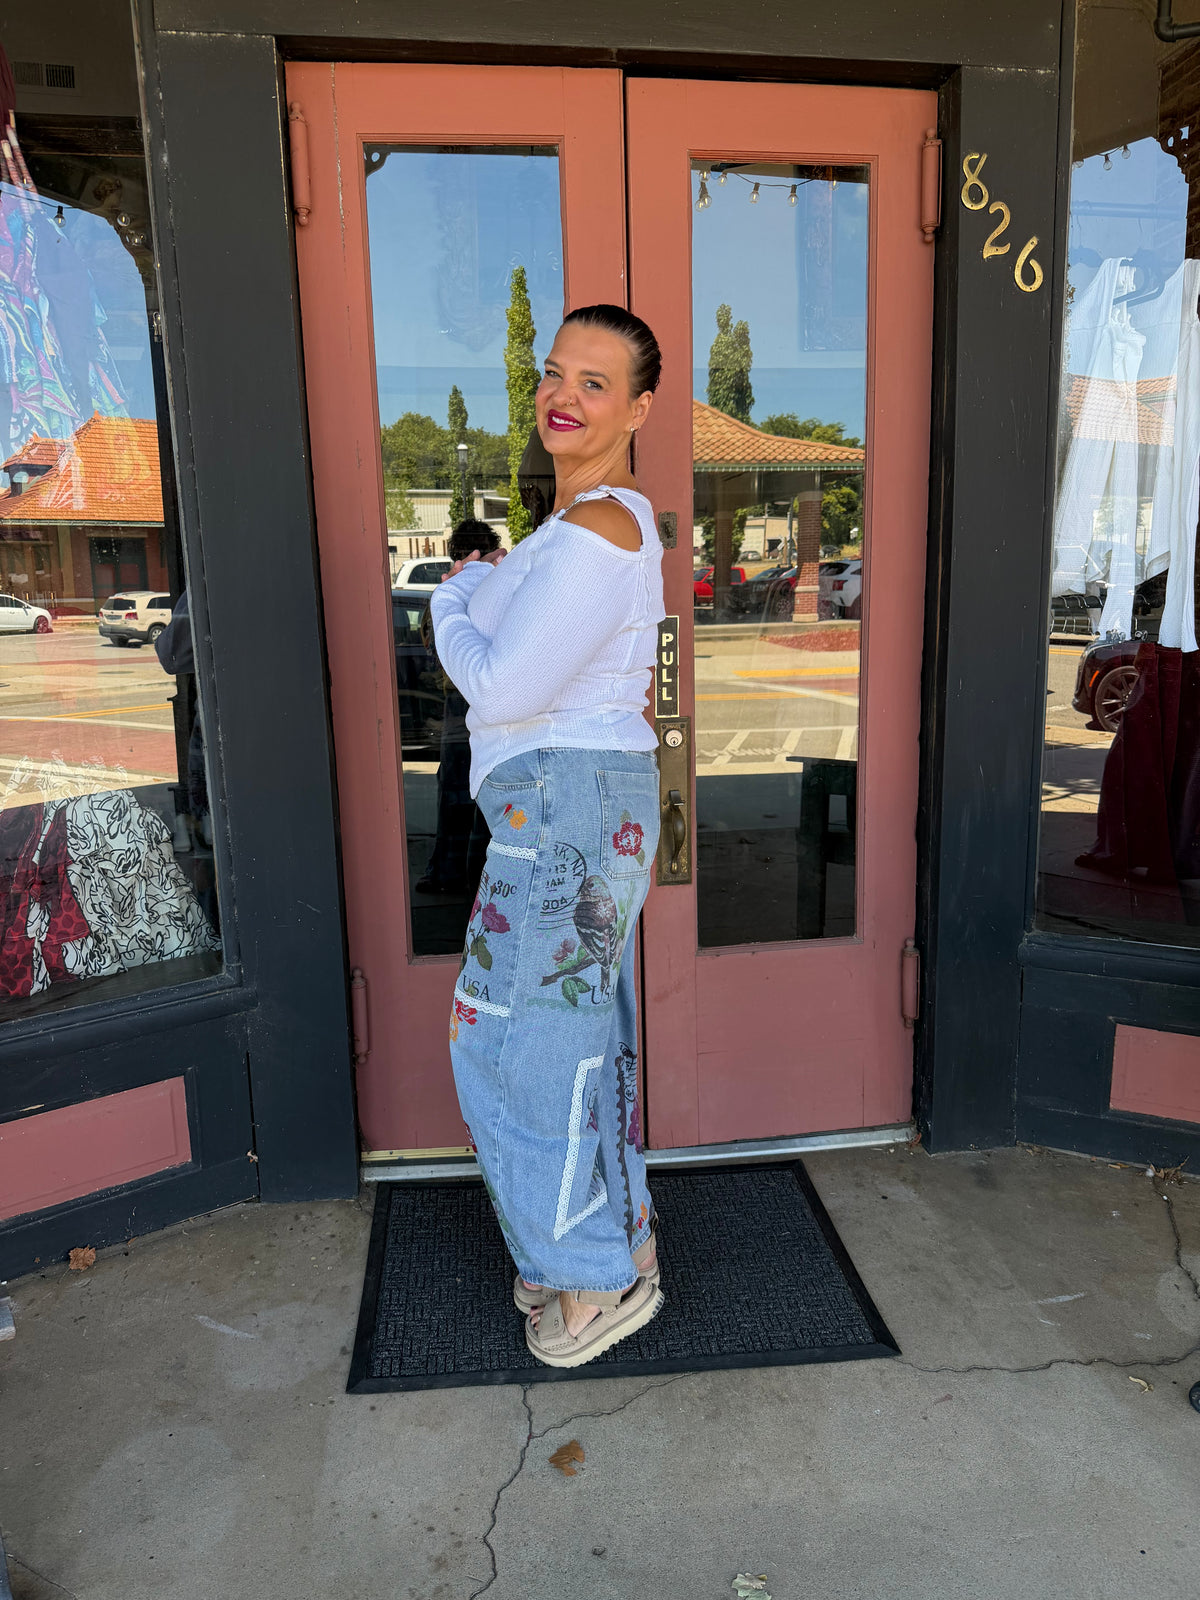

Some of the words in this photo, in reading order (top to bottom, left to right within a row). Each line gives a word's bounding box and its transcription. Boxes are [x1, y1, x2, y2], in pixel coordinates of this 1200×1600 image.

[961, 152, 1043, 292] 826
[661, 633, 674, 701] PULL
[462, 974, 491, 1003] USA
